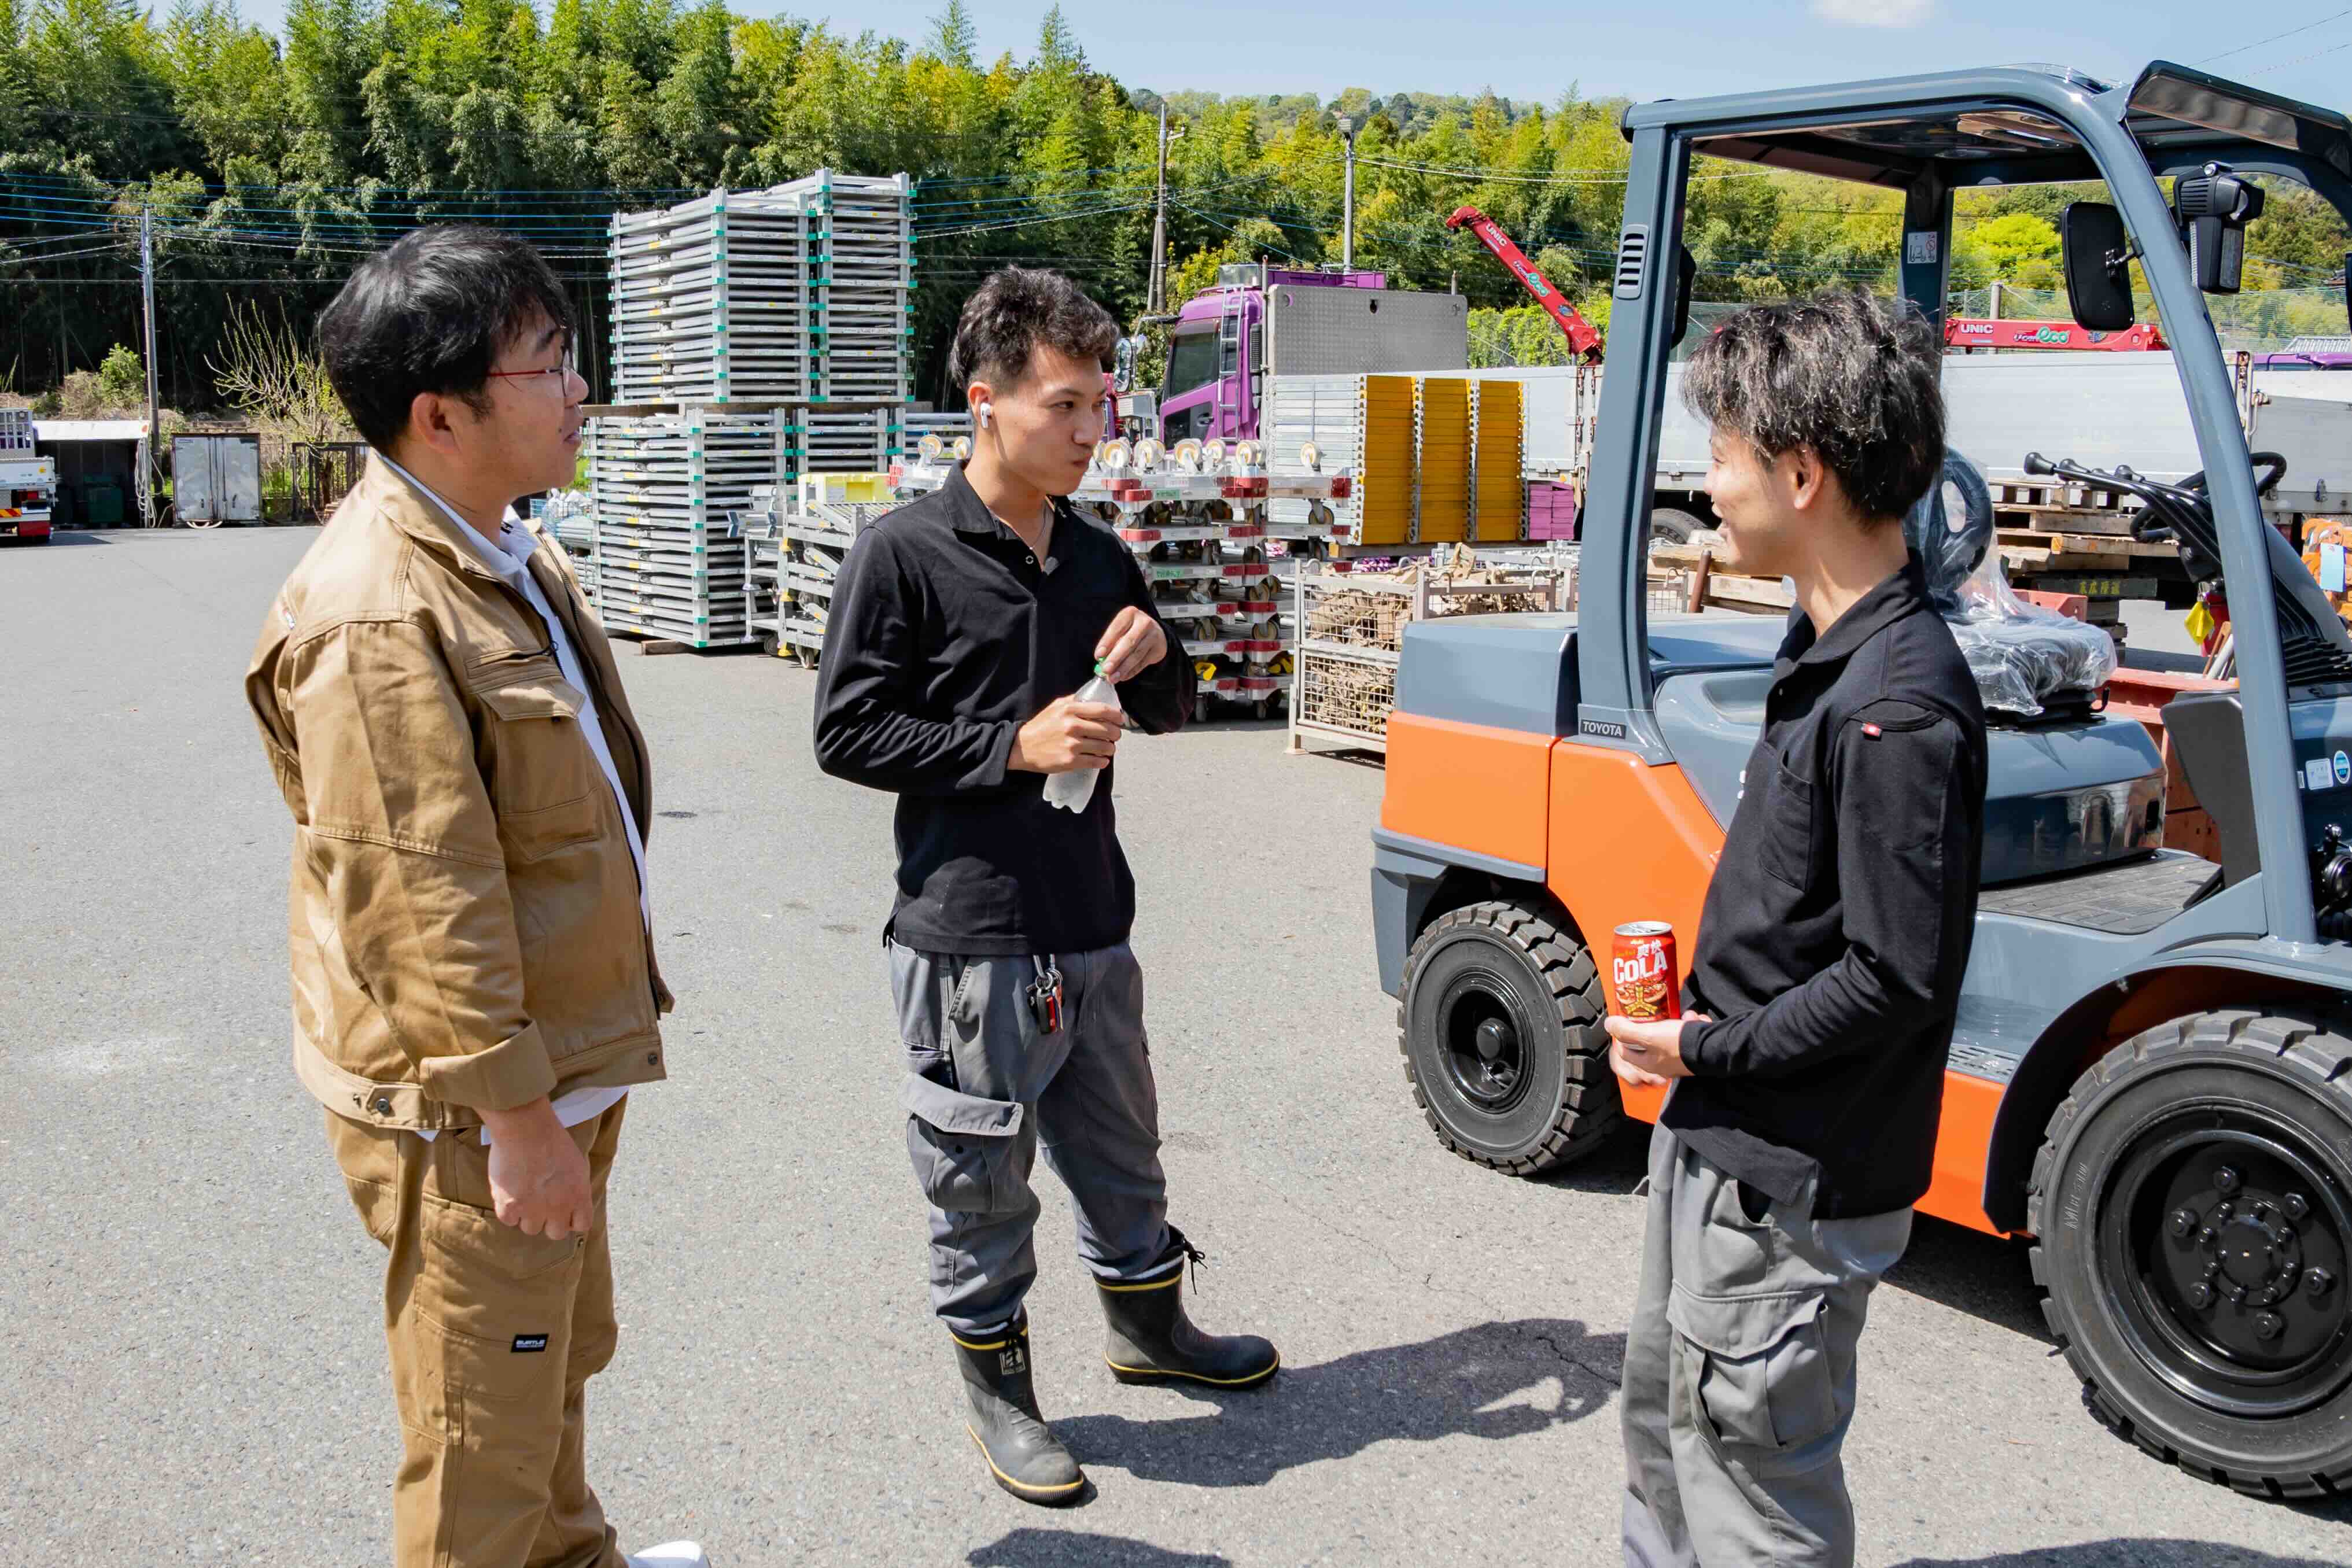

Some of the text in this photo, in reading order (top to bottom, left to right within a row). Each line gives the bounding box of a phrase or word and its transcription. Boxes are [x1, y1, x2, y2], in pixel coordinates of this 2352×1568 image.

[1485, 223, 1507, 246] UNIC
[1960, 324, 1993, 334] UNIC
[1583, 721, 1622, 736] TOYOTA
[1614, 950, 1668, 984] COLA
